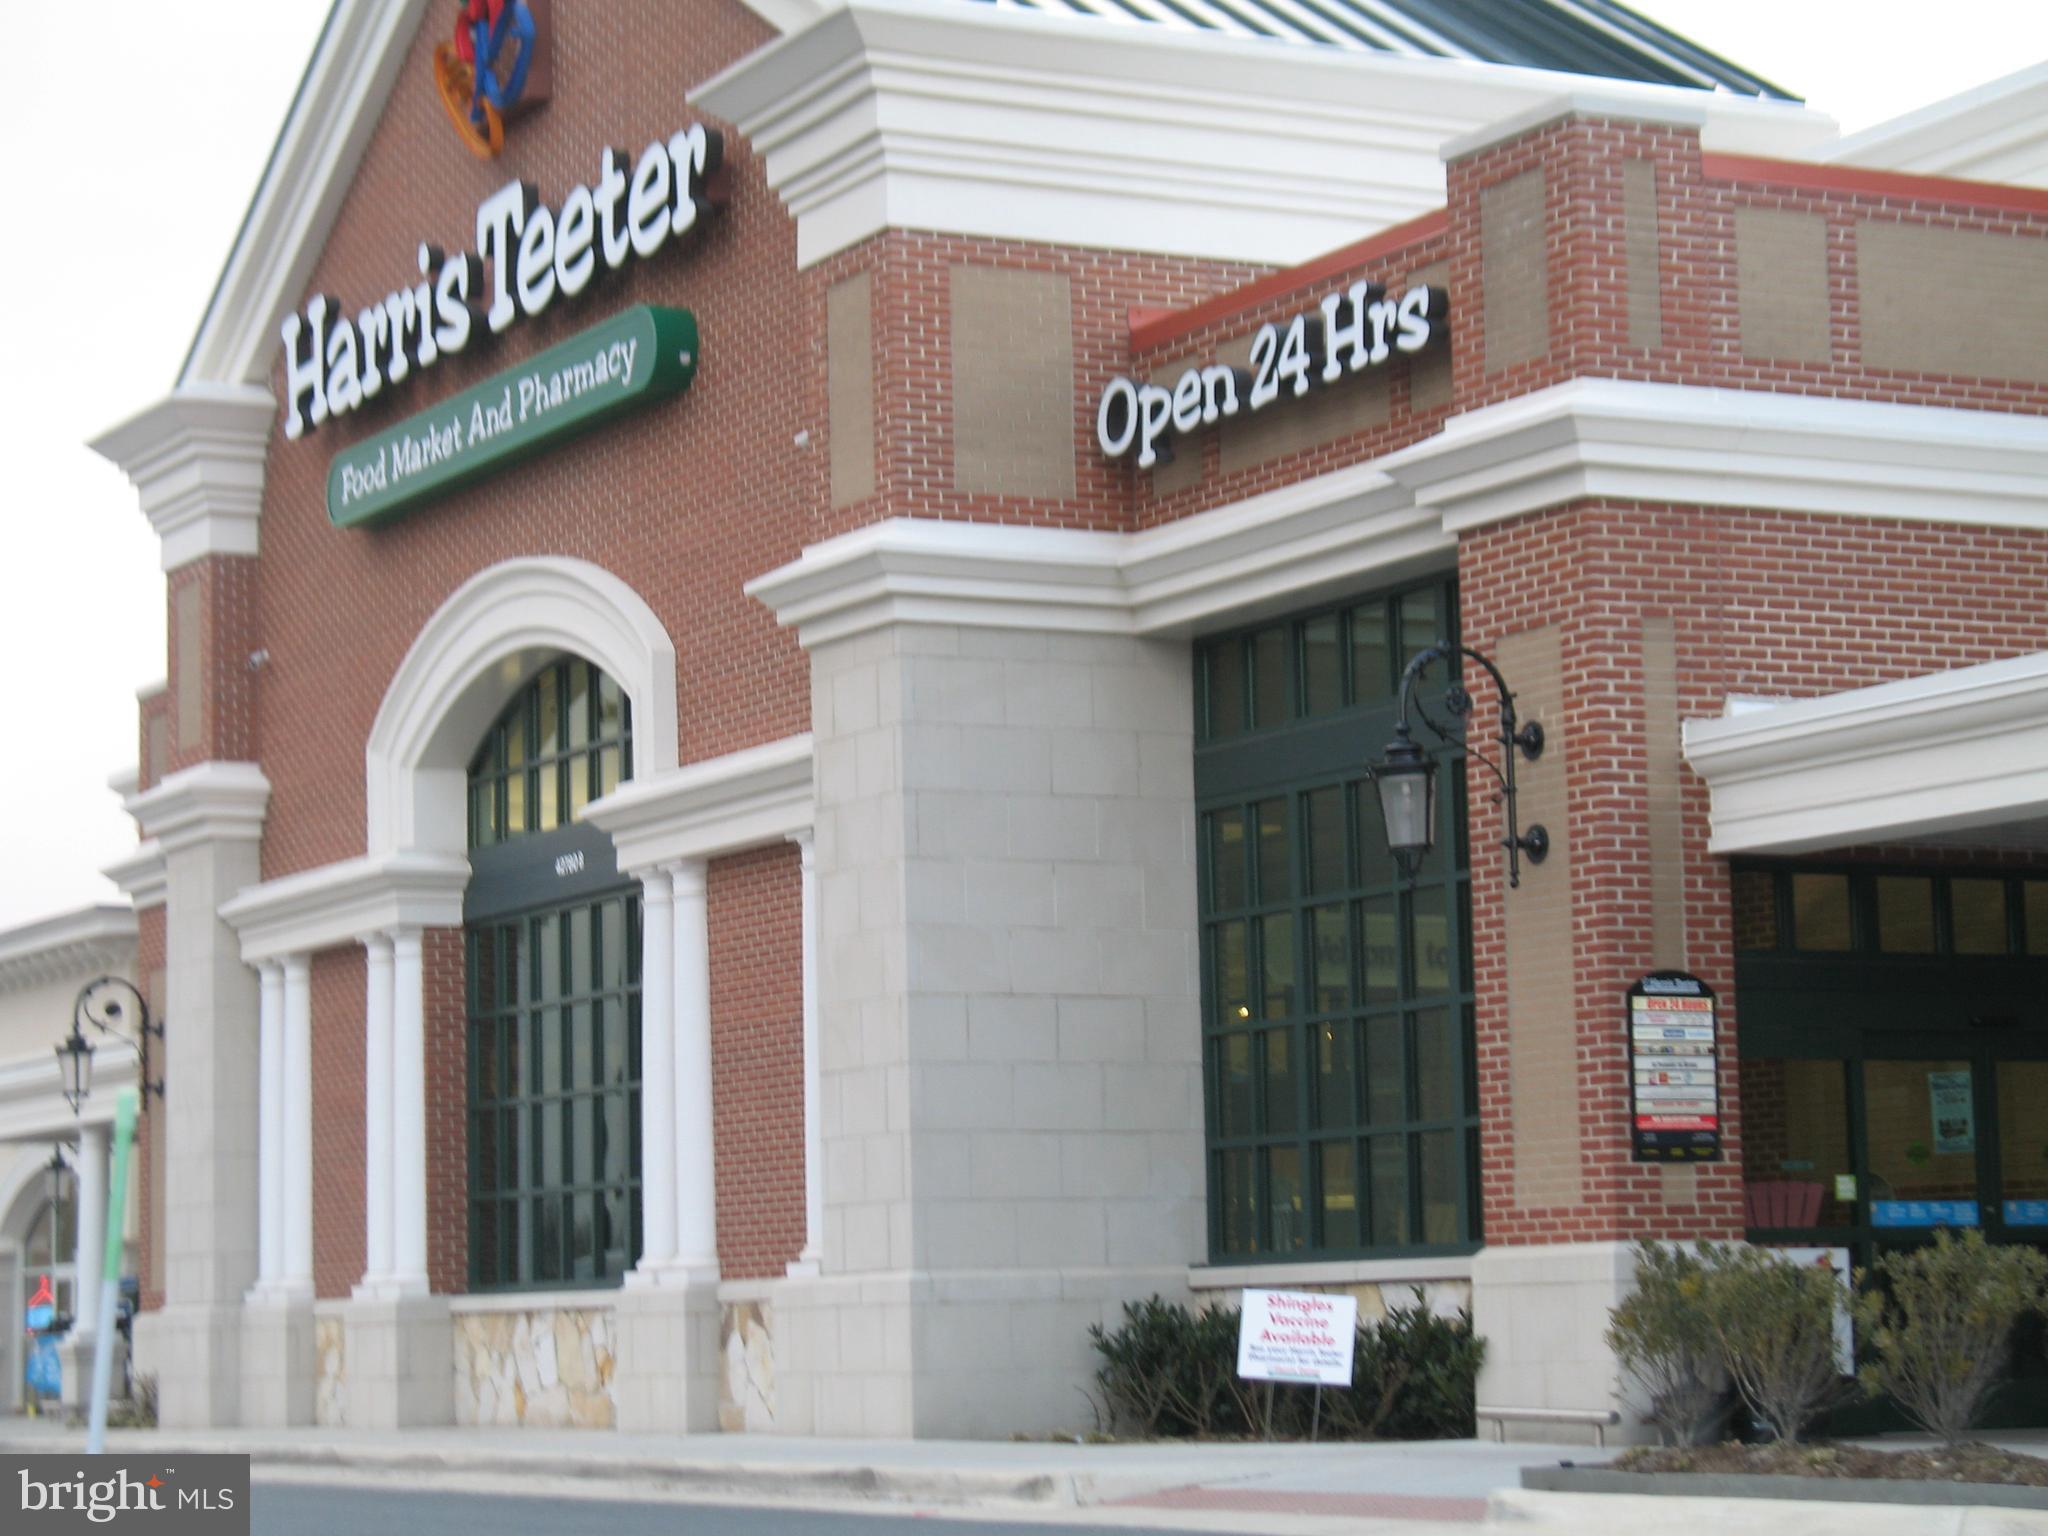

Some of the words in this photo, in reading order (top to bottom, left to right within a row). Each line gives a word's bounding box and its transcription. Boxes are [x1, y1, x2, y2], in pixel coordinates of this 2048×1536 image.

[281, 241, 473, 440] Harris
[476, 122, 709, 334] Teeter
[340, 454, 388, 506] Food
[391, 416, 463, 483] Market
[467, 387, 512, 447] And
[517, 335, 638, 423] Pharmacy
[1096, 363, 1241, 470] Open
[1248, 312, 1312, 412] 24
[1320, 278, 1431, 383] Hrs
[1261, 1329, 1336, 1345] Available
